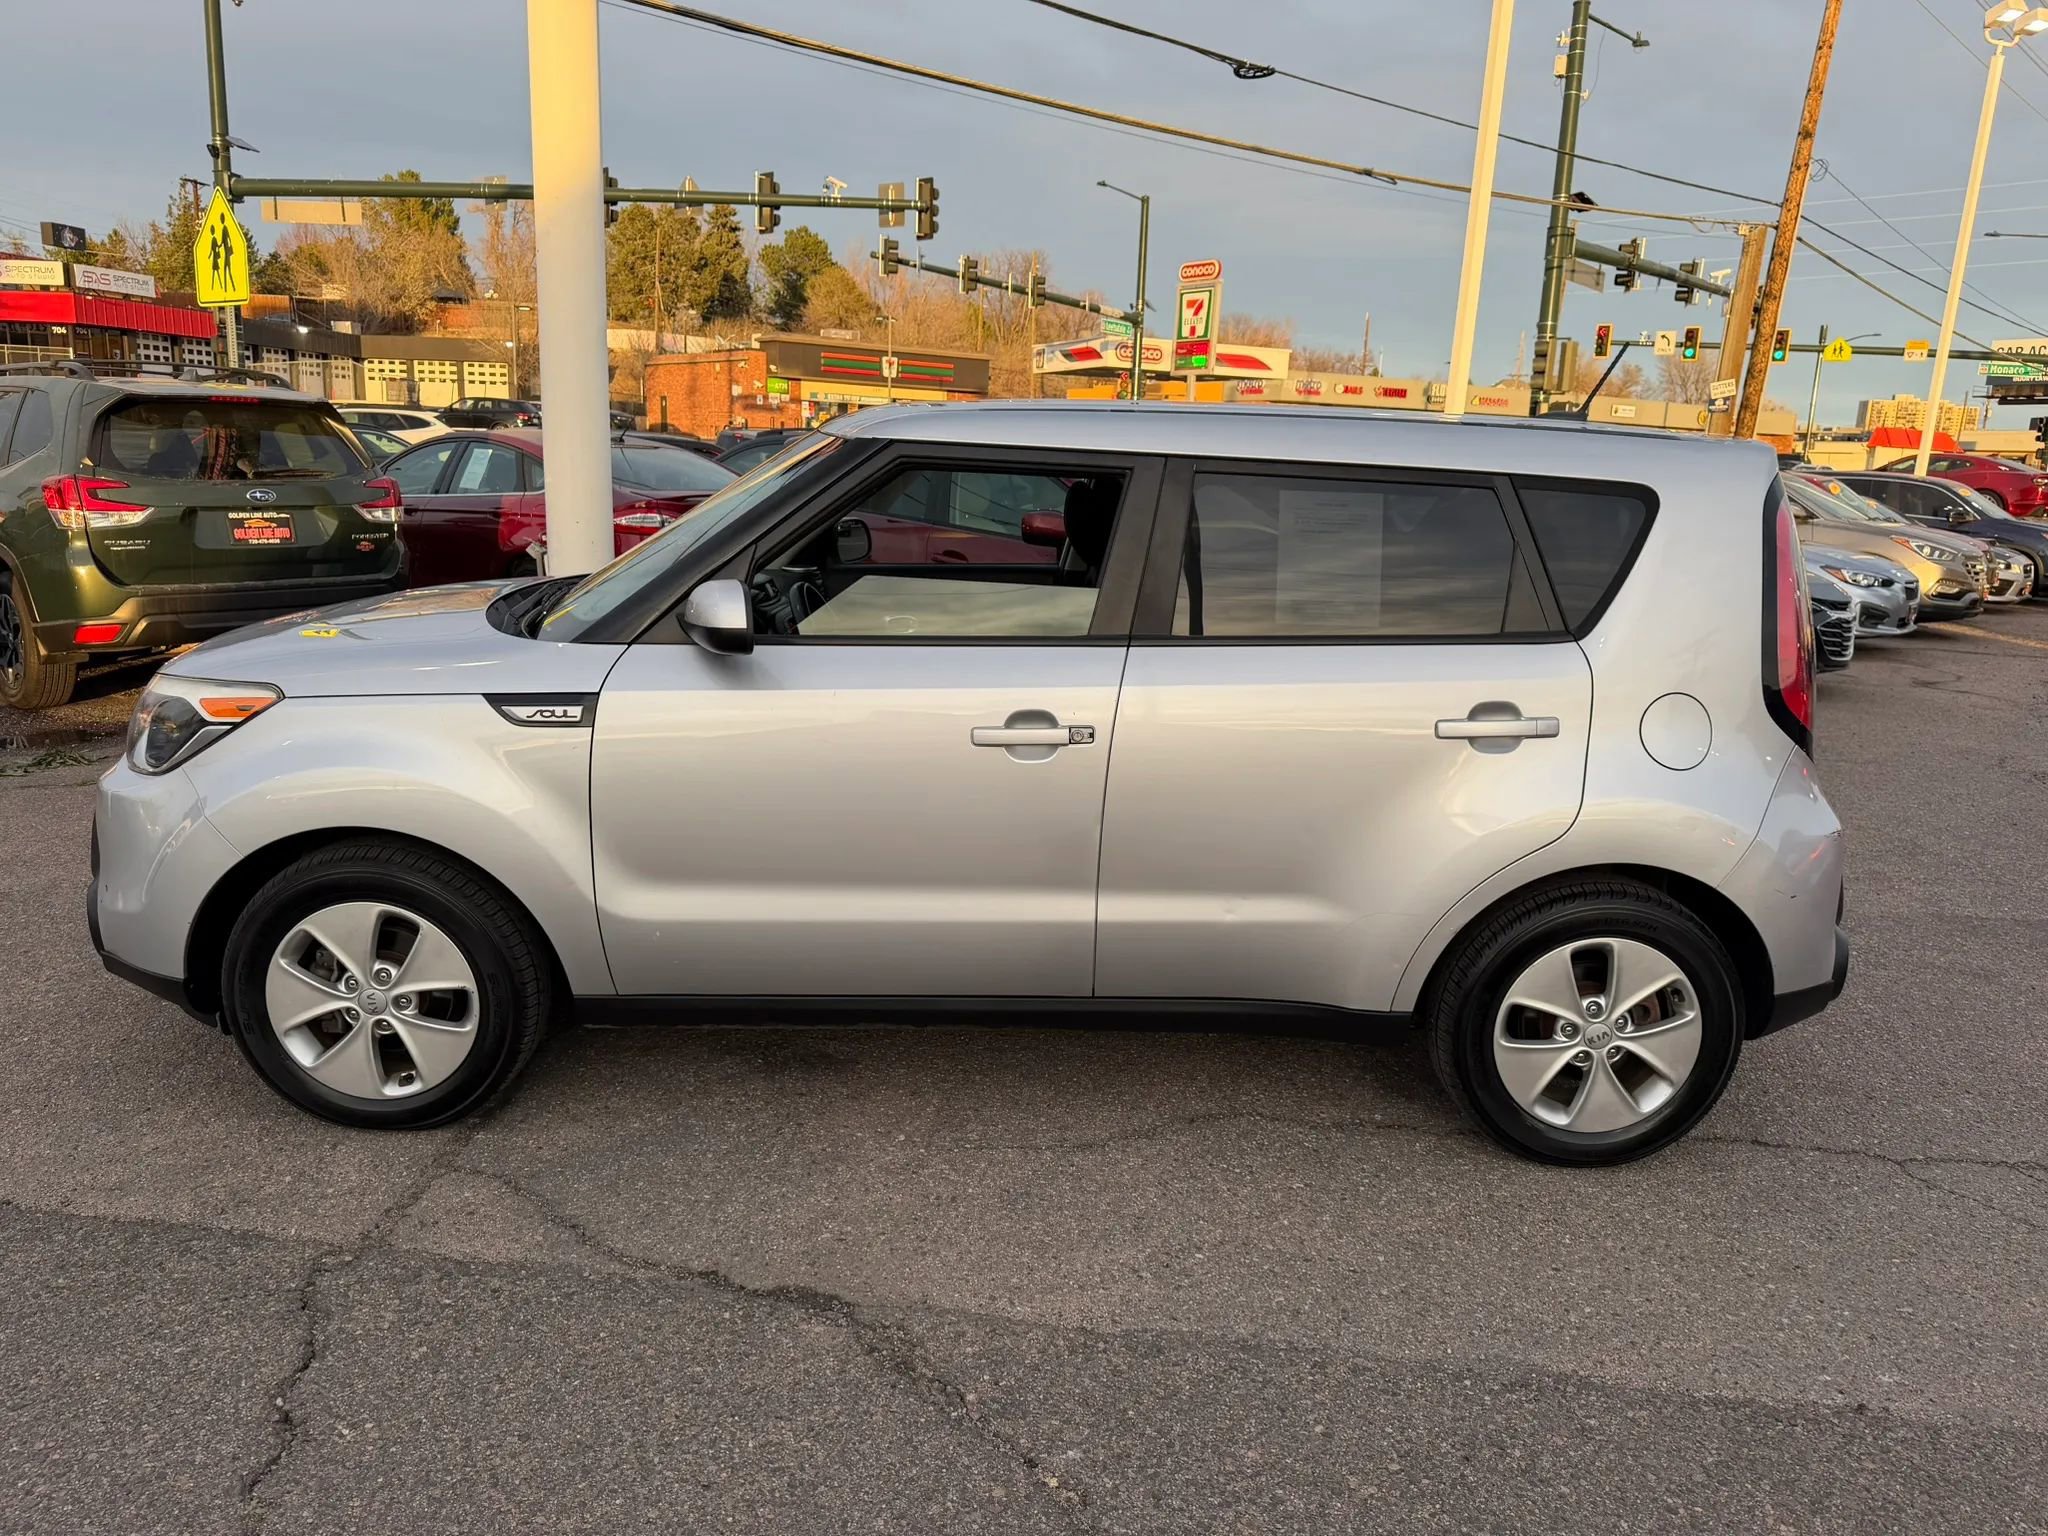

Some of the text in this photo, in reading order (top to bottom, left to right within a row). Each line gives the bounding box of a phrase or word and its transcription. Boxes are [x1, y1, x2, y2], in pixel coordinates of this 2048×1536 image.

[4, 265, 55, 274] SPECTRUM
[113, 275, 149, 287] SPECTRUM
[51, 326, 67, 334] 704
[1120, 345, 1162, 360] cooco
[1990, 365, 2025, 374] Monaco
[233, 528, 259, 539] GOLDEN
[274, 527, 291, 538] AUTO
[366, 992, 378, 1014] KIA
[1587, 1031, 1610, 1045] KIA
